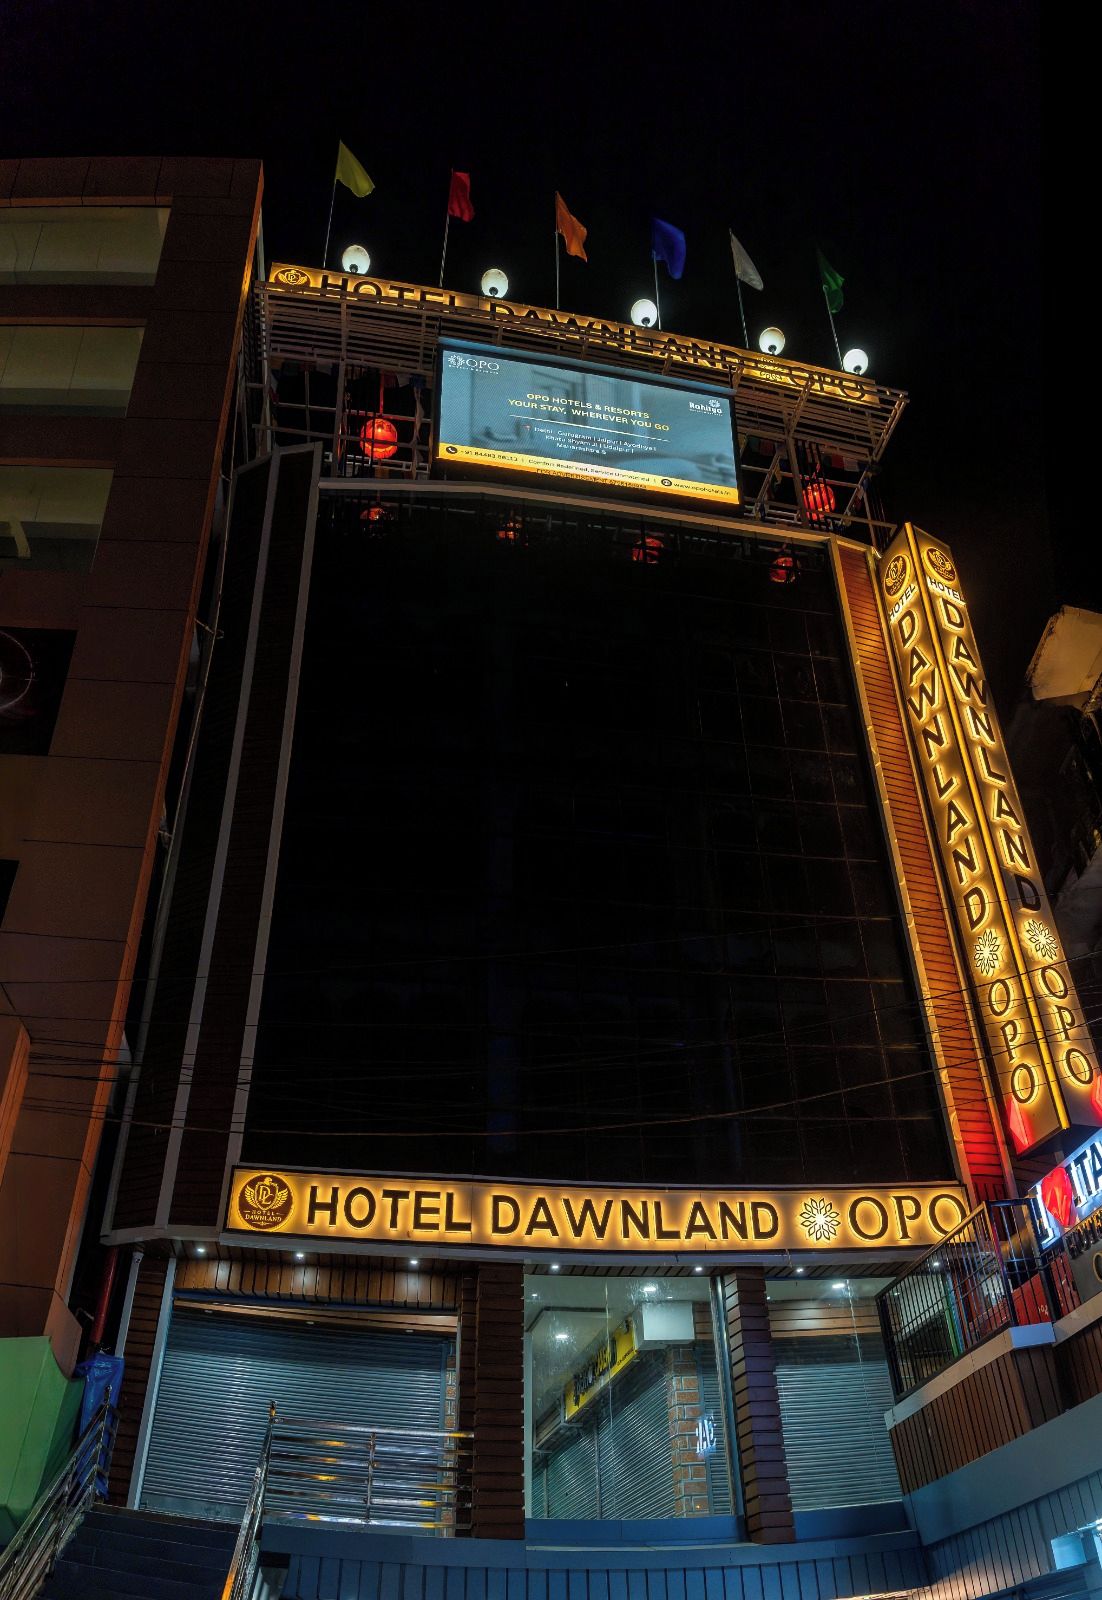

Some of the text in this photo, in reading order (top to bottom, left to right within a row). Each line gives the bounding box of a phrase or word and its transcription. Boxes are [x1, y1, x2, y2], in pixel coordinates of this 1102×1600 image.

[466, 358, 500, 371] OPO
[508, 399, 538, 409] YOUR
[571, 408, 629, 424] WHEREVER
[630, 418, 652, 428] YOU
[654, 423, 670, 431] GO
[526, 393, 550, 402] OPO
[552, 396, 593, 409] HOTELS
[604, 405, 650, 419] RESORTS
[888, 584, 916, 618] HOTEL
[896, 609, 988, 931] DAWNLAND
[942, 598, 1042, 912] DAWNLAND
[1041, 966, 1093, 1085] OPO
[988, 979, 1036, 1104] OPO
[245, 1214, 282, 1222] DAWNLAND
[307, 1185, 966, 1242] HOTEL DAWNLAND OPO
